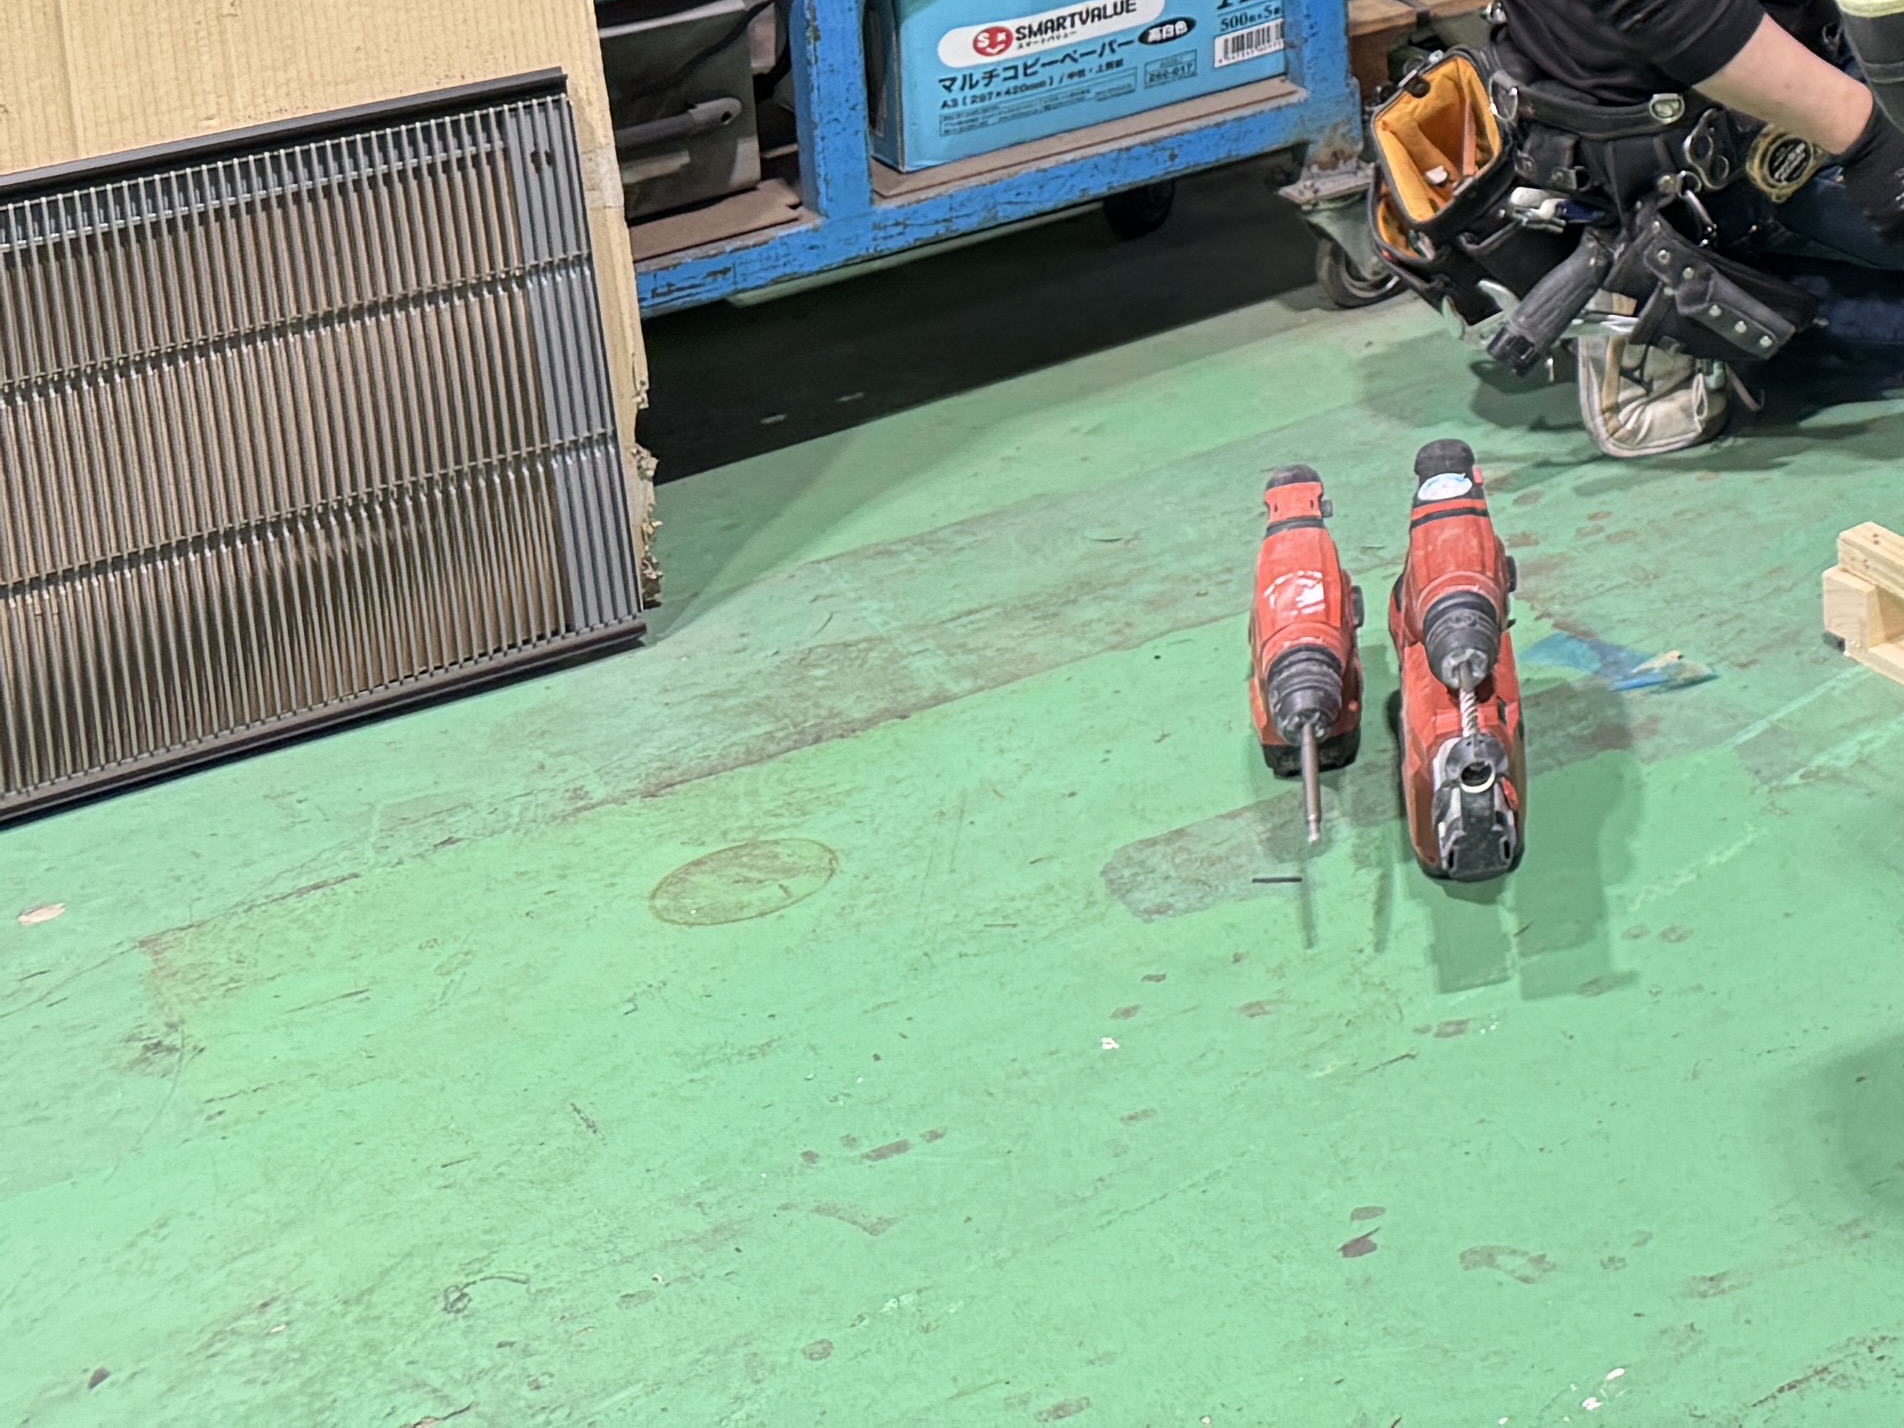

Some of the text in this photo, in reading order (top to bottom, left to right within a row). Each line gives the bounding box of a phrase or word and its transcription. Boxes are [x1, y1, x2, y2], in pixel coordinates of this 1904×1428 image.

[938, 37, 1136, 94] マルチコピーペーパー
